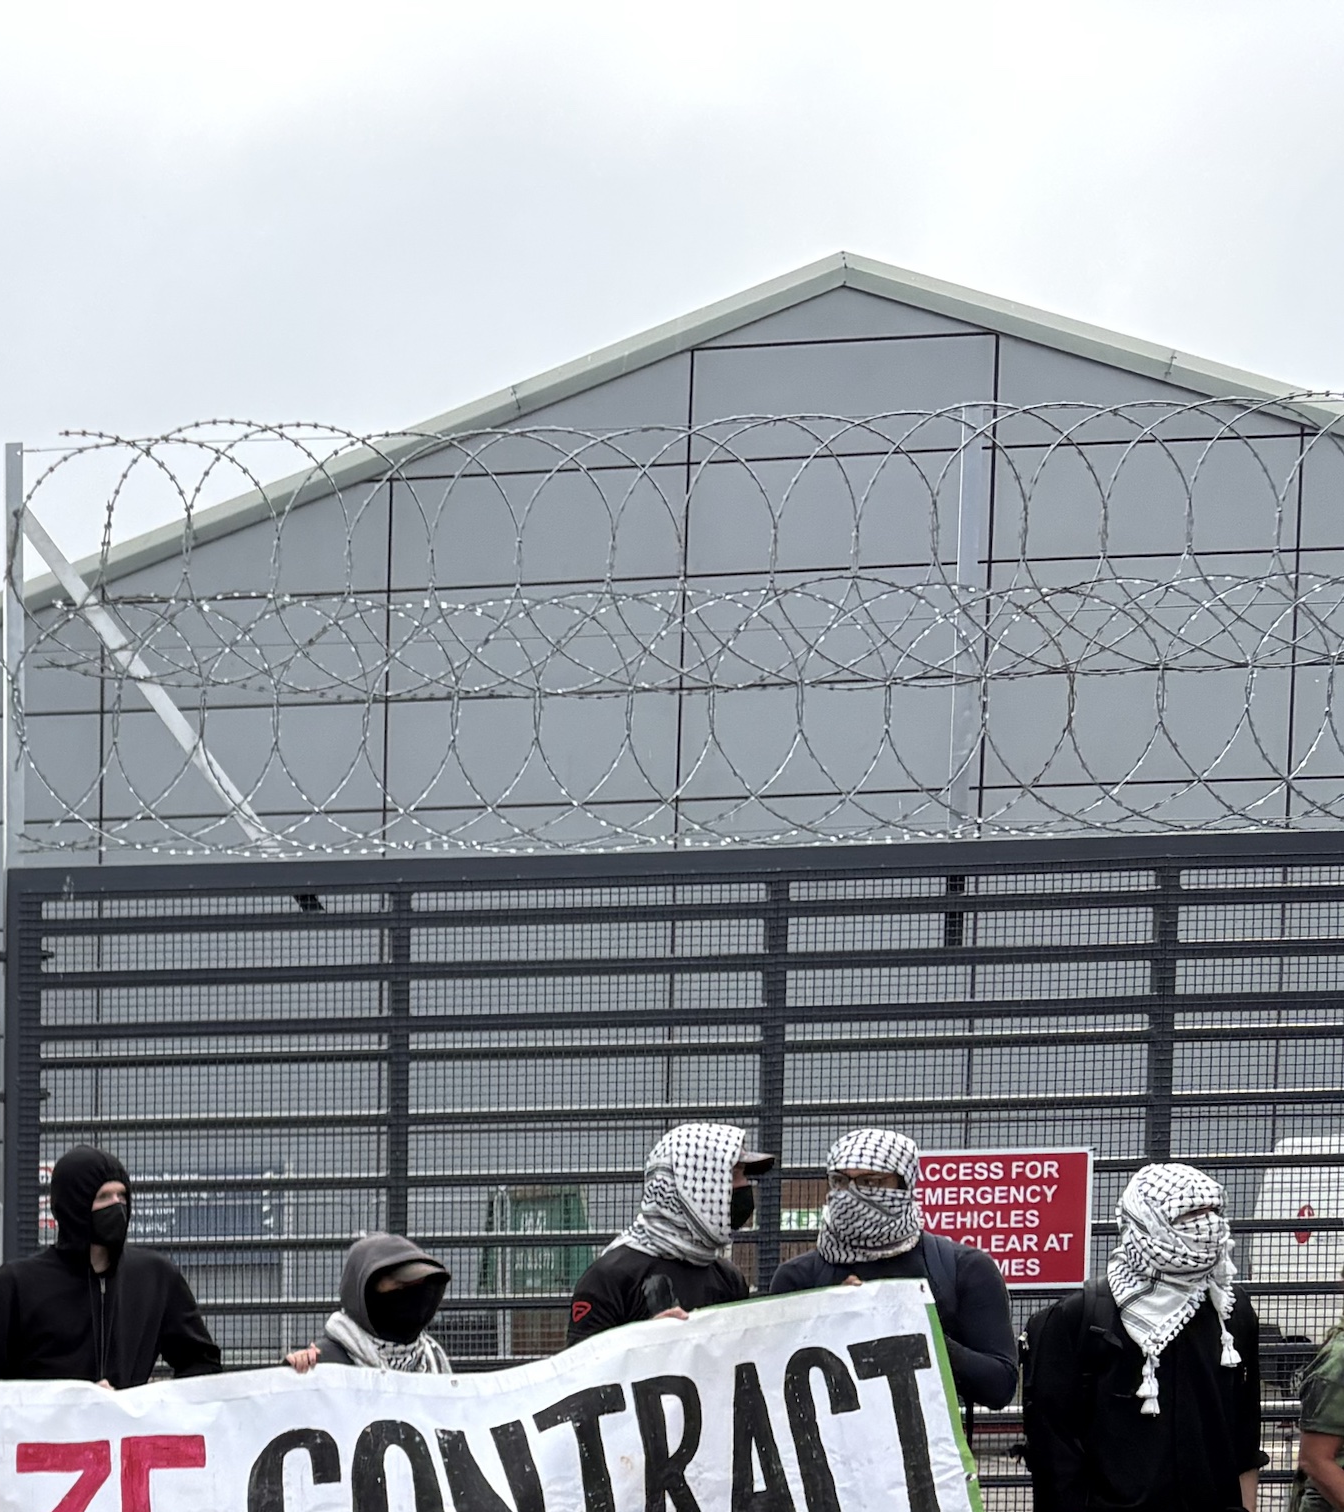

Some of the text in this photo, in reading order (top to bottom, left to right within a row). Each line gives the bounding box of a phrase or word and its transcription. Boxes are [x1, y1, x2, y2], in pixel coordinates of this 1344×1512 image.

[1011, 1160, 1060, 1180] FOR
[912, 1185, 1058, 1205] EMERGENCY
[925, 1210, 1040, 1230] VEHICLES
[960, 1233, 1073, 1252] CLEAR AT
[995, 1259, 1040, 1277] MES
